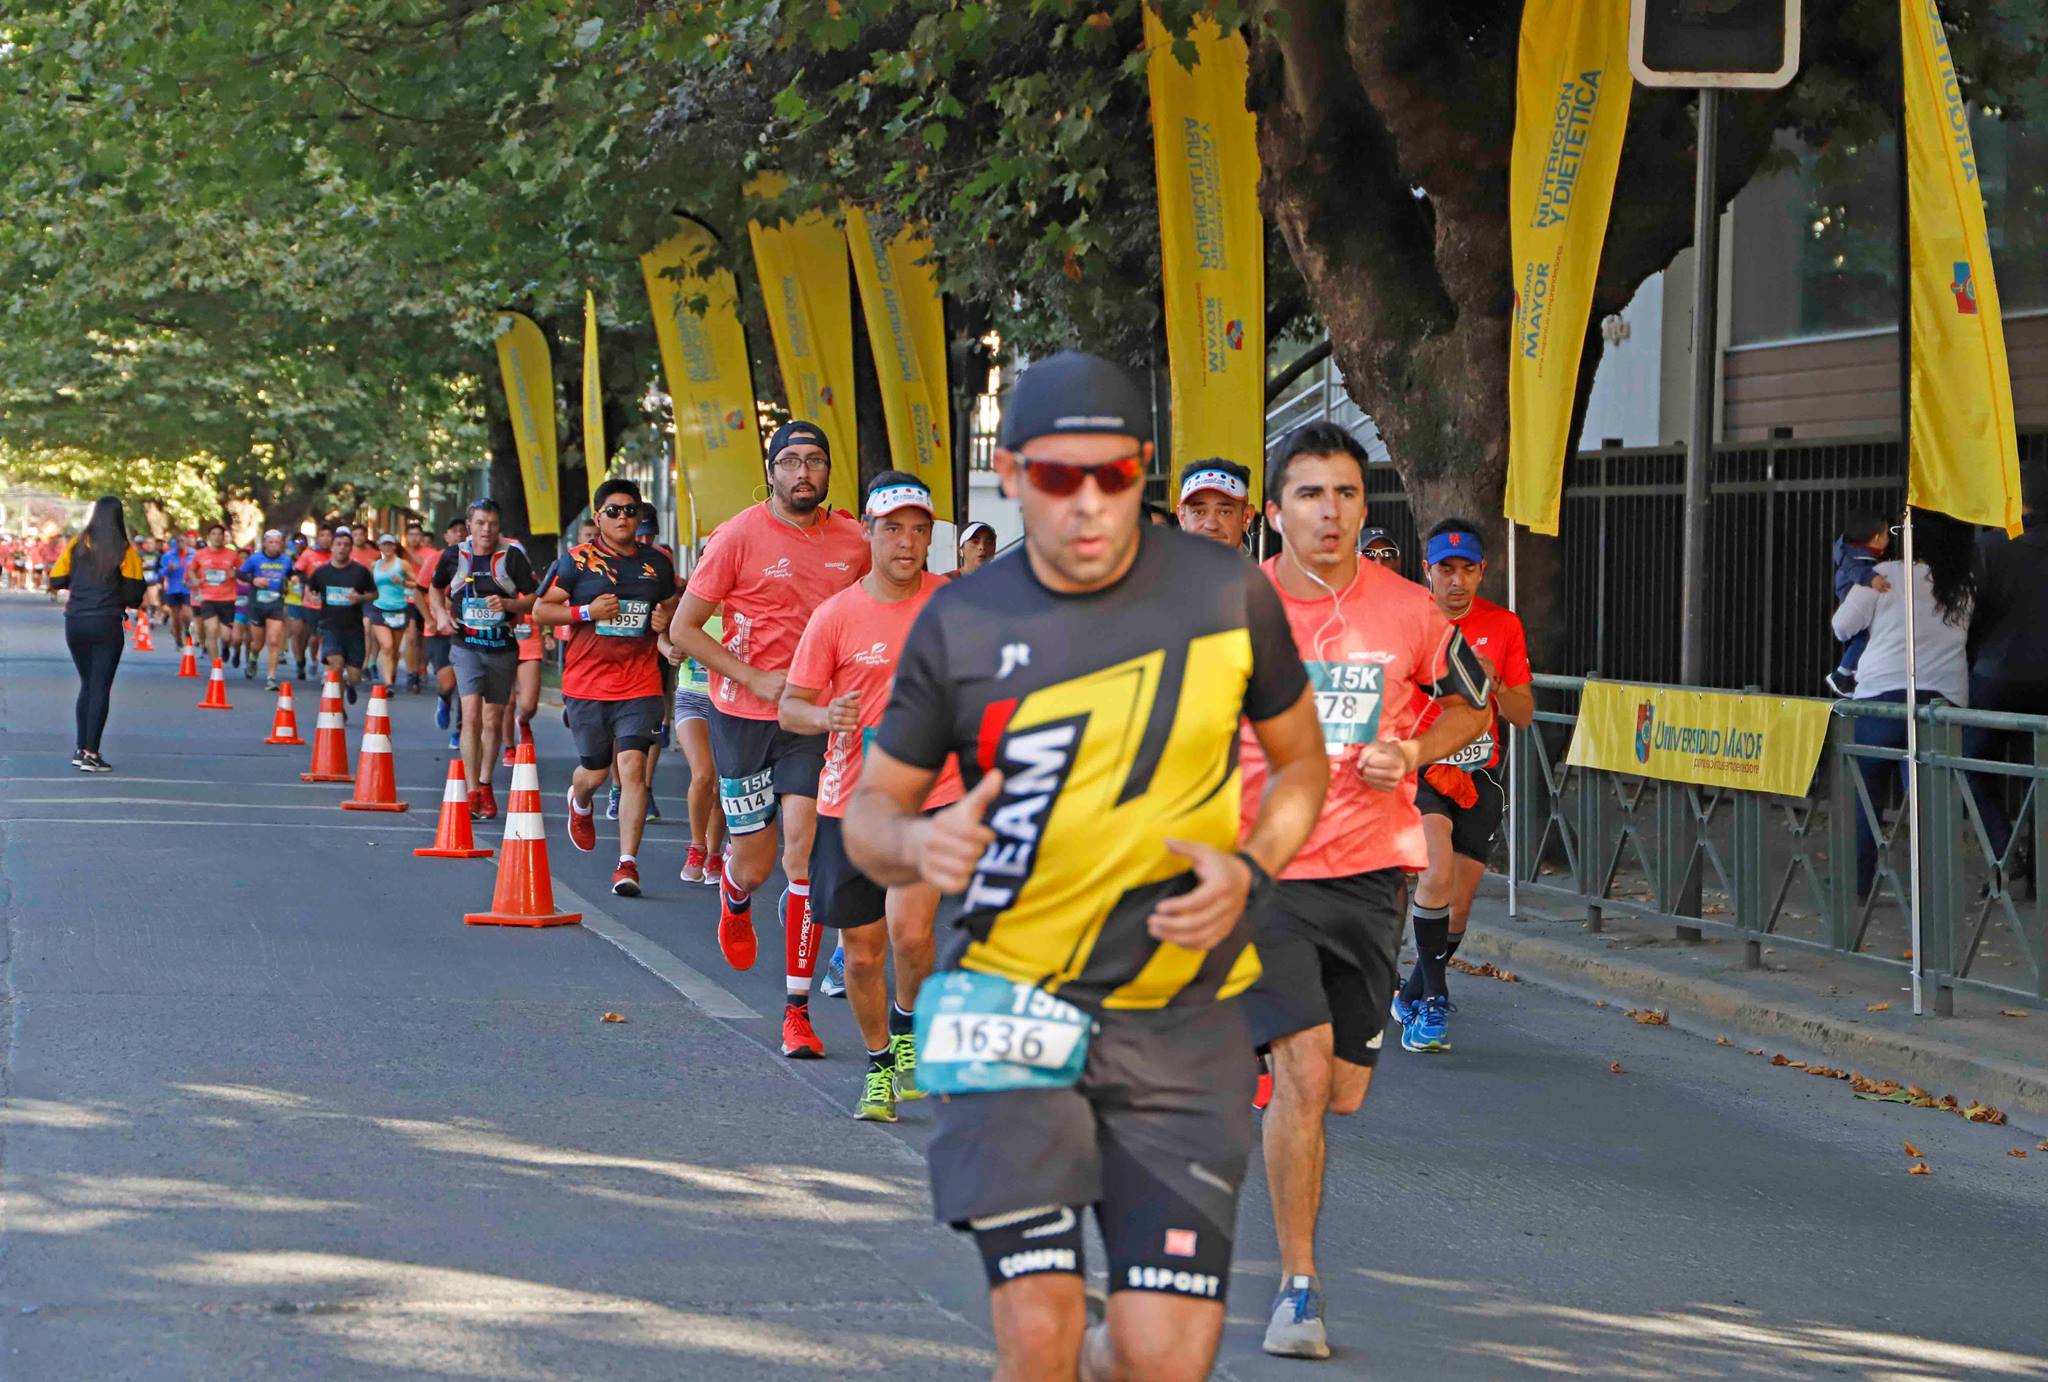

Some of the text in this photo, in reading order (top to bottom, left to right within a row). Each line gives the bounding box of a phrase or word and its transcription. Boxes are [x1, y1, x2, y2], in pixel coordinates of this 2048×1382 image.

[1536, 81, 1574, 229] NUTRICIÓN
[1548, 210, 1564, 228] Y
[1525, 263, 1550, 358] MAYOR
[627, 602, 649, 613] 15K
[608, 614, 639, 626] 1995
[1330, 666, 1380, 690] 15K
[1313, 694, 1357, 719] 78
[742, 770, 773, 794] 15K
[726, 793, 766, 814] 1114
[963, 725, 1076, 913] TEAM
[951, 1020, 1043, 1060] 1636
